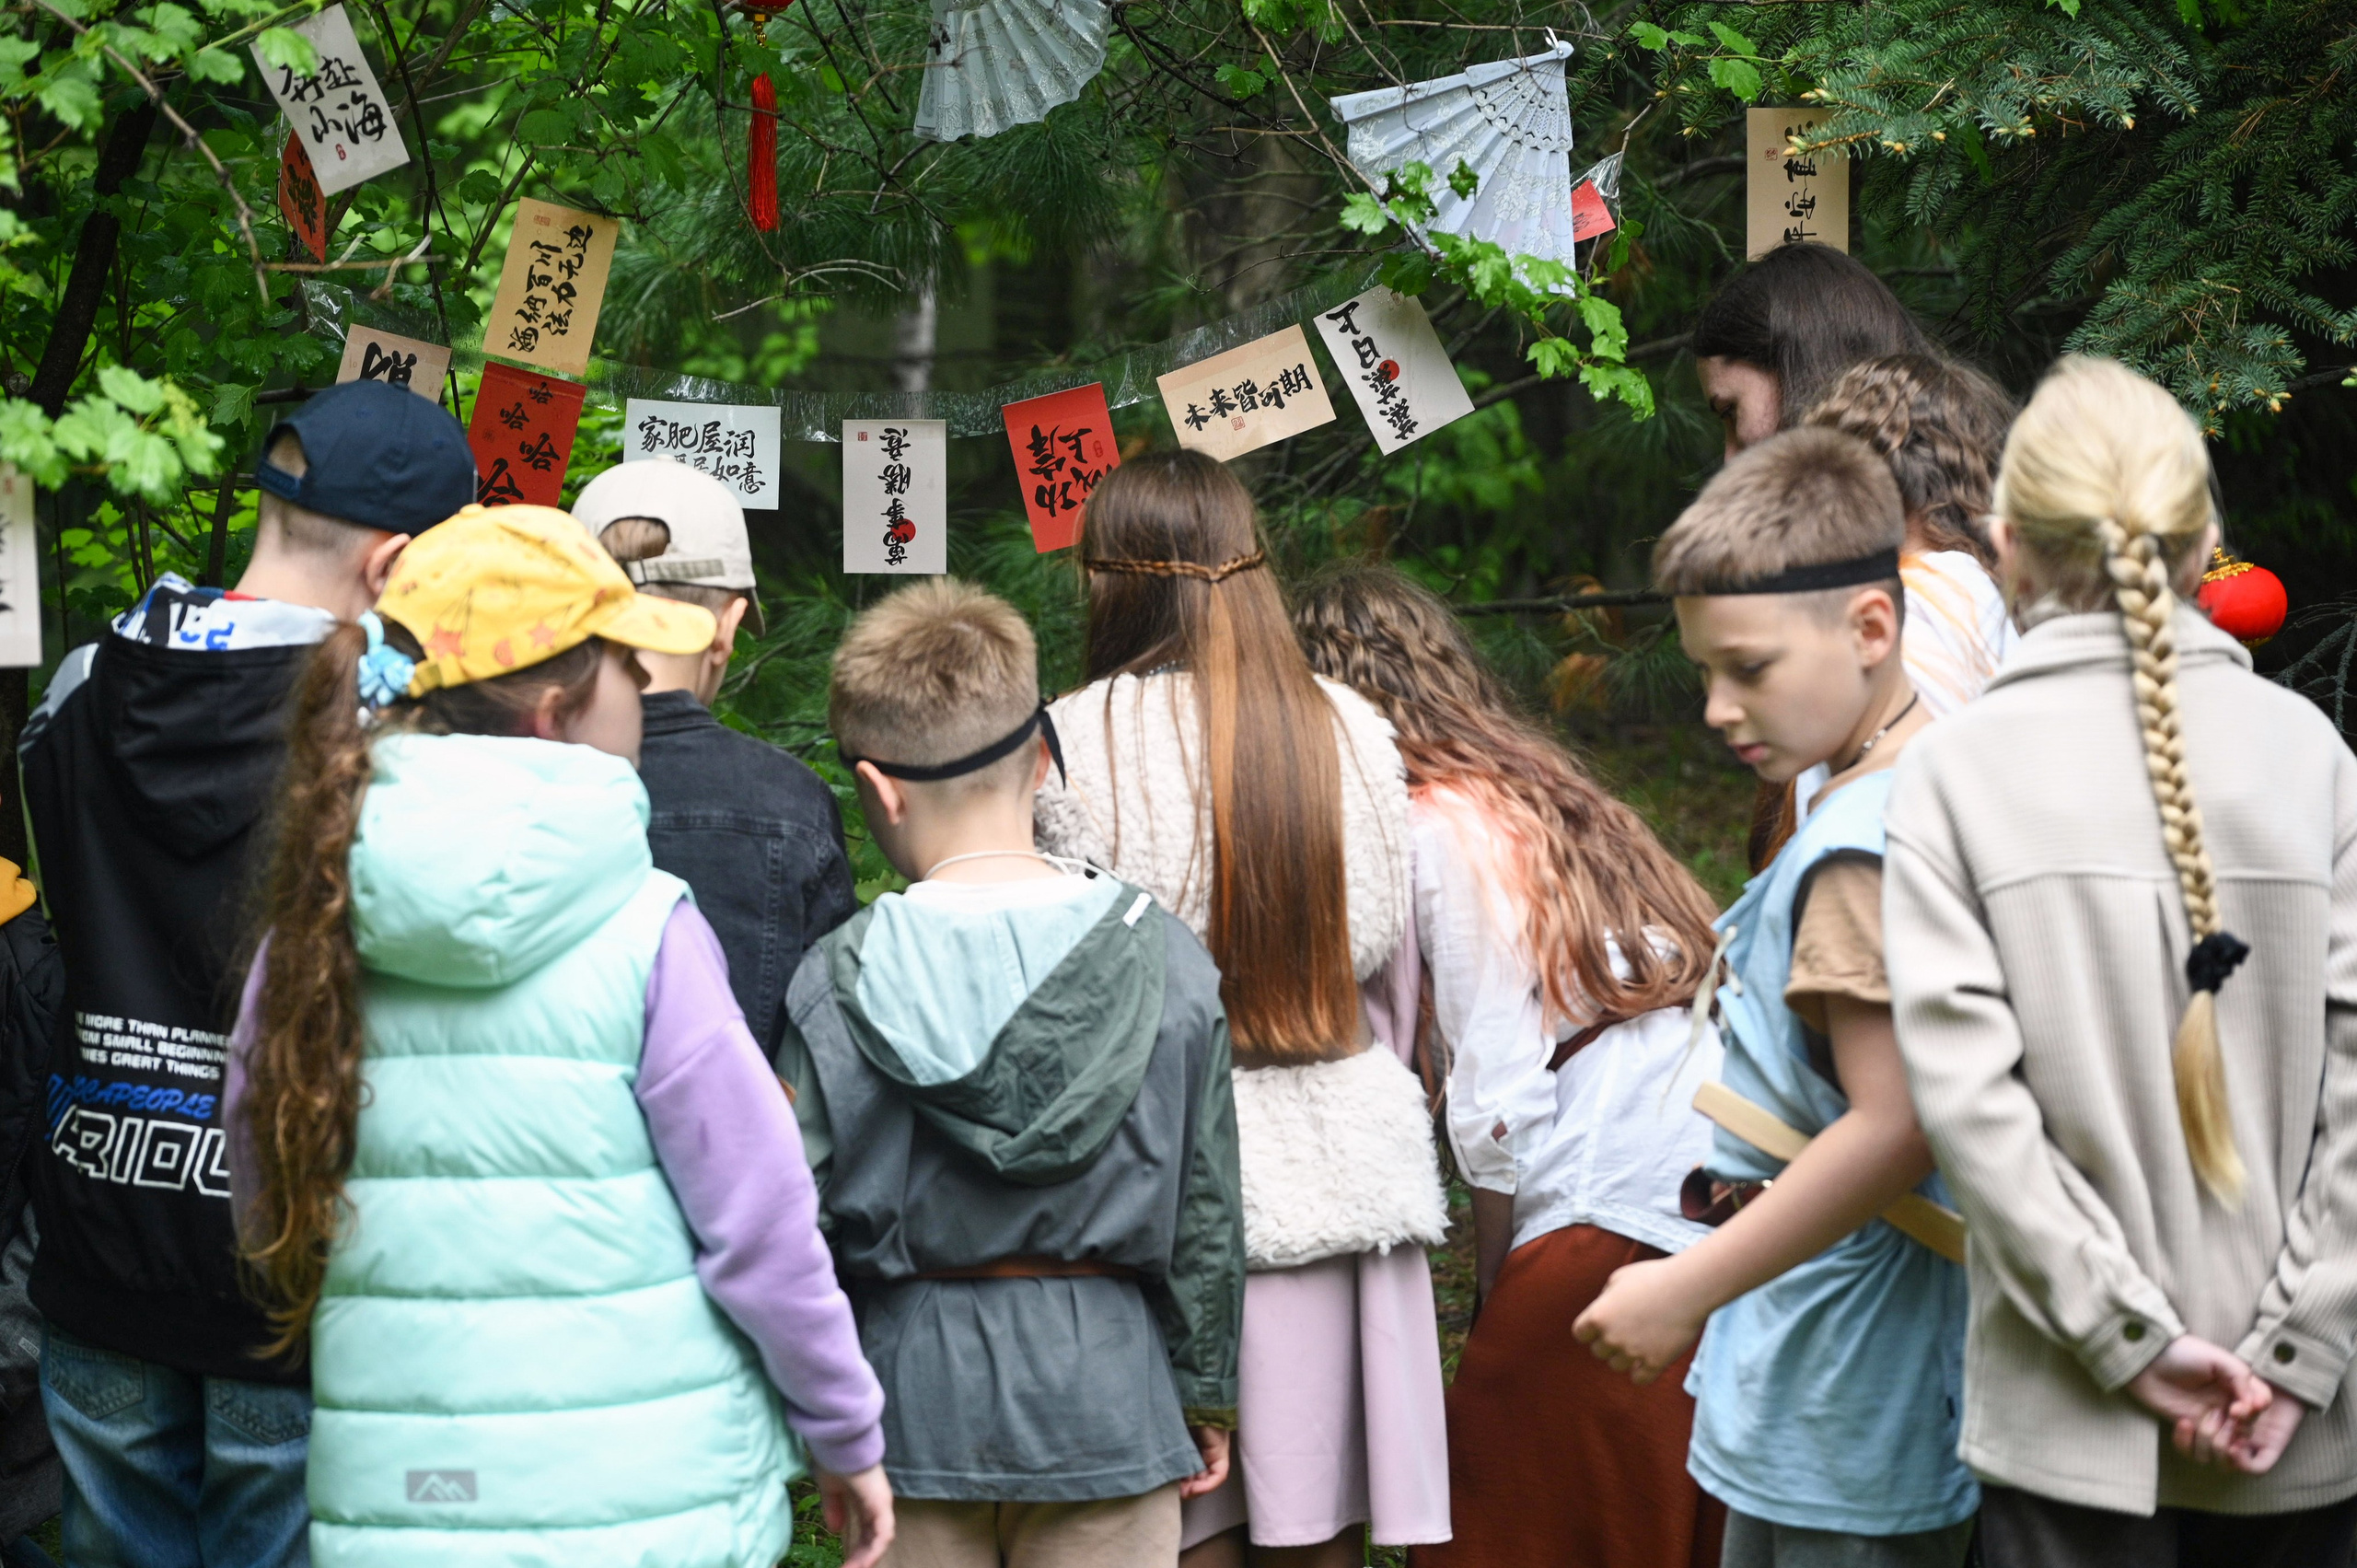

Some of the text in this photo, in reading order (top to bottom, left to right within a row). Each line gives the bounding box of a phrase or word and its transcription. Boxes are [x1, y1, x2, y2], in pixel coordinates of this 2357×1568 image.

[1184, 363, 1314, 432] 未来皆可期
[638, 415, 756, 460] 家肥屋润
[85, 1014, 124, 1032] MORE
[127, 1018, 168, 1040] THAN
[170, 1027, 230, 1048] PLANNE
[103, 1033, 154, 1053] SMALL
[110, 1052, 162, 1072] GREAT
[166, 1059, 221, 1080] THINGS
